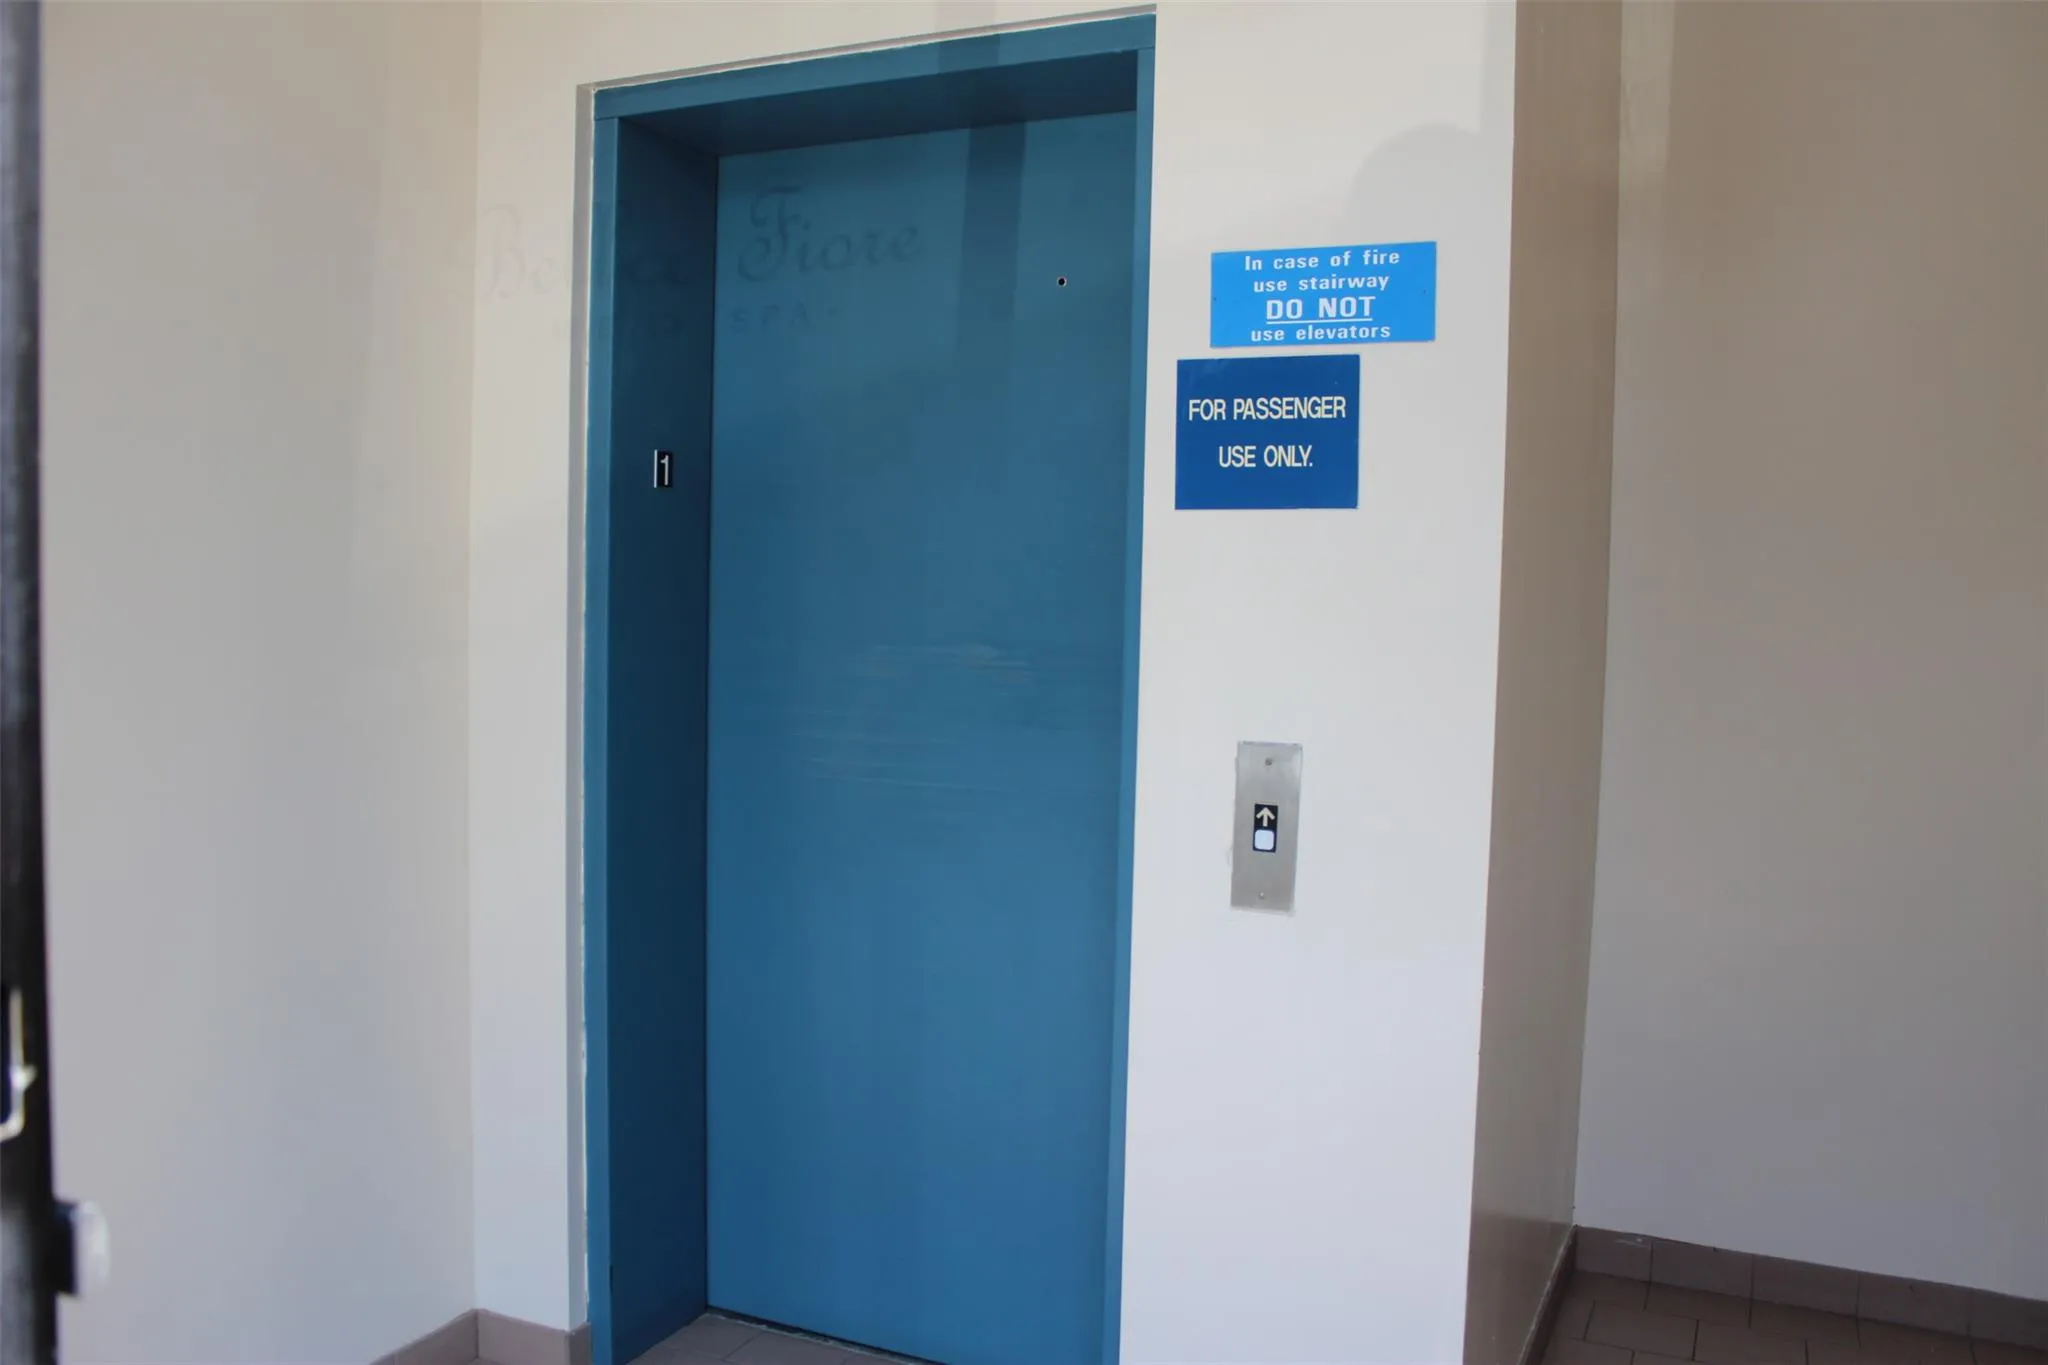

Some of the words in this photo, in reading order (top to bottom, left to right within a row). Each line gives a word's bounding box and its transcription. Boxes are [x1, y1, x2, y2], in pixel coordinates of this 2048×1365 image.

[738, 185, 924, 283] Fiore
[1244, 255, 1262, 272] In
[1273, 255, 1319, 271] case
[1330, 250, 1351, 268] of
[1362, 248, 1401, 266] fire
[1253, 278, 1288, 293] use
[1298, 274, 1390, 292] stairway
[1265, 298, 1304, 320] DO
[1318, 296, 1376, 318] NOT
[1250, 328, 1285, 342] use
[1296, 324, 1391, 341] elevators
[1188, 398, 1227, 421] FOR
[1232, 396, 1347, 420] PASSENGER
[1218, 445, 1257, 468] USE
[1263, 444, 1314, 468] ONLY.
[660, 454, 669, 486] 1
